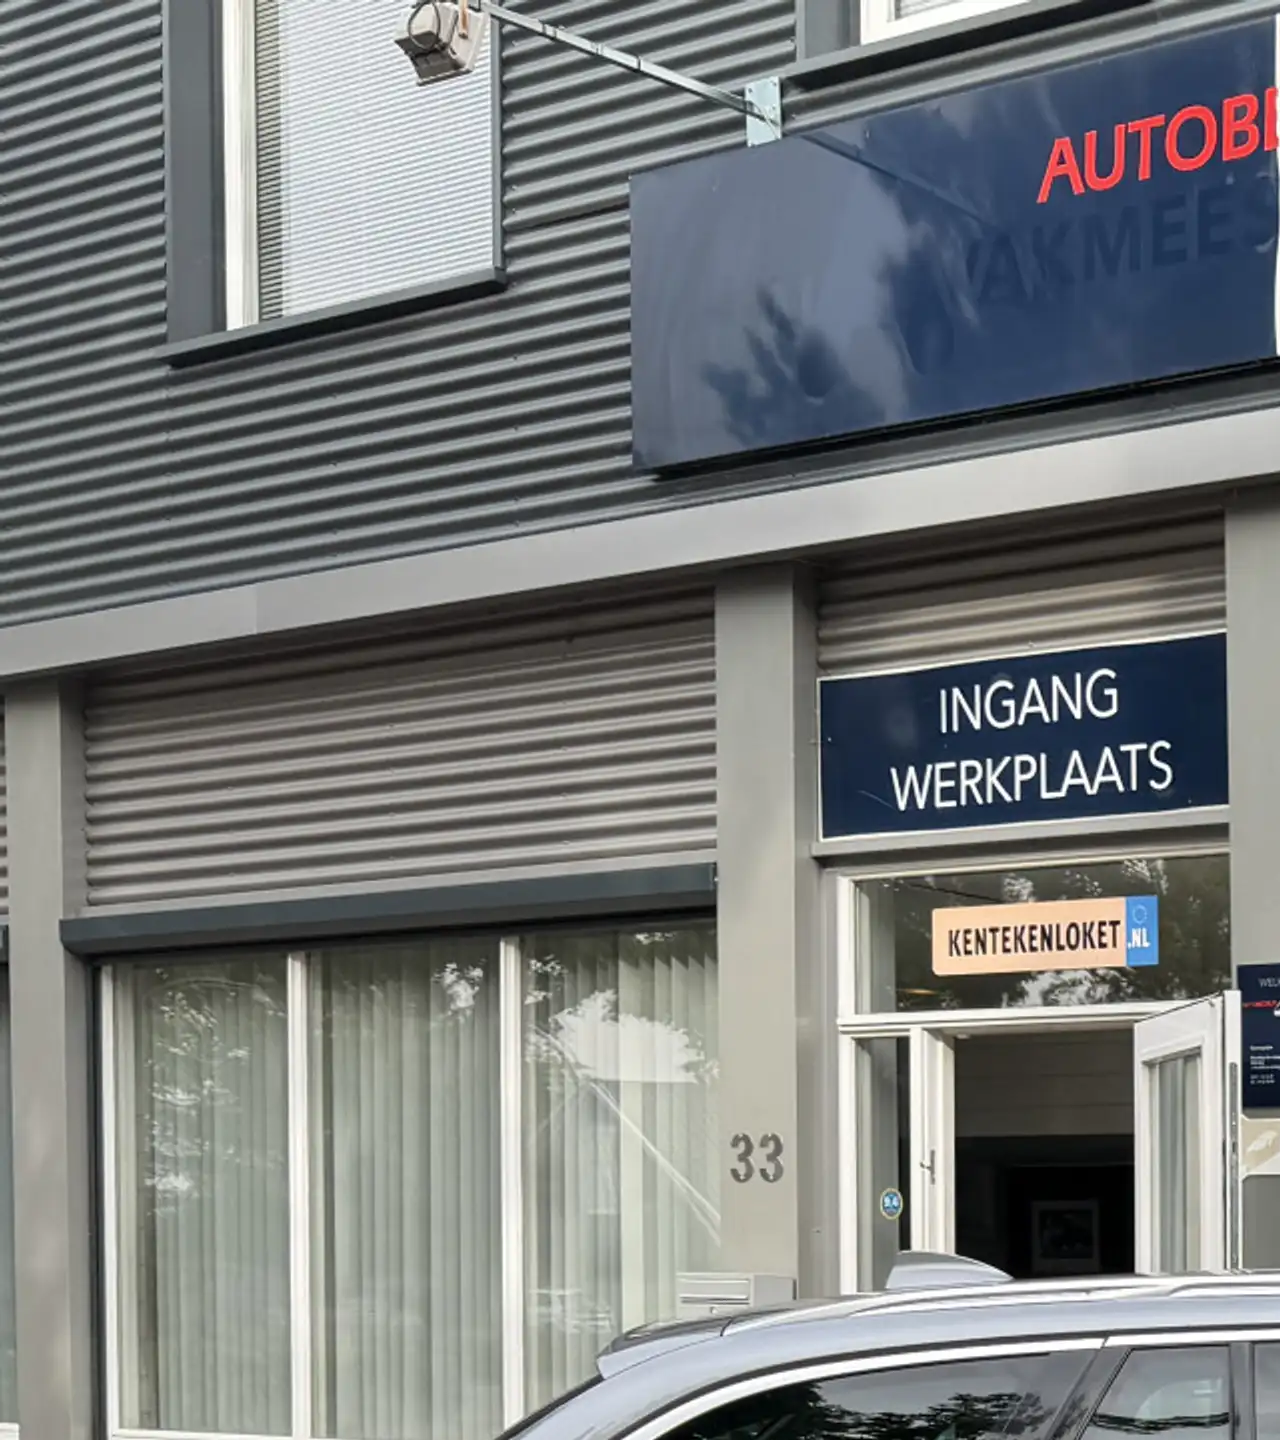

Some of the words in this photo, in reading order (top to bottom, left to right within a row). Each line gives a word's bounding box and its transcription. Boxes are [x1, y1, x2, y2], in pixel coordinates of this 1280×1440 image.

[940, 667, 1118, 733] INGANG
[890, 740, 1173, 812] WERKPLAATS
[730, 1133, 784, 1183] 33
